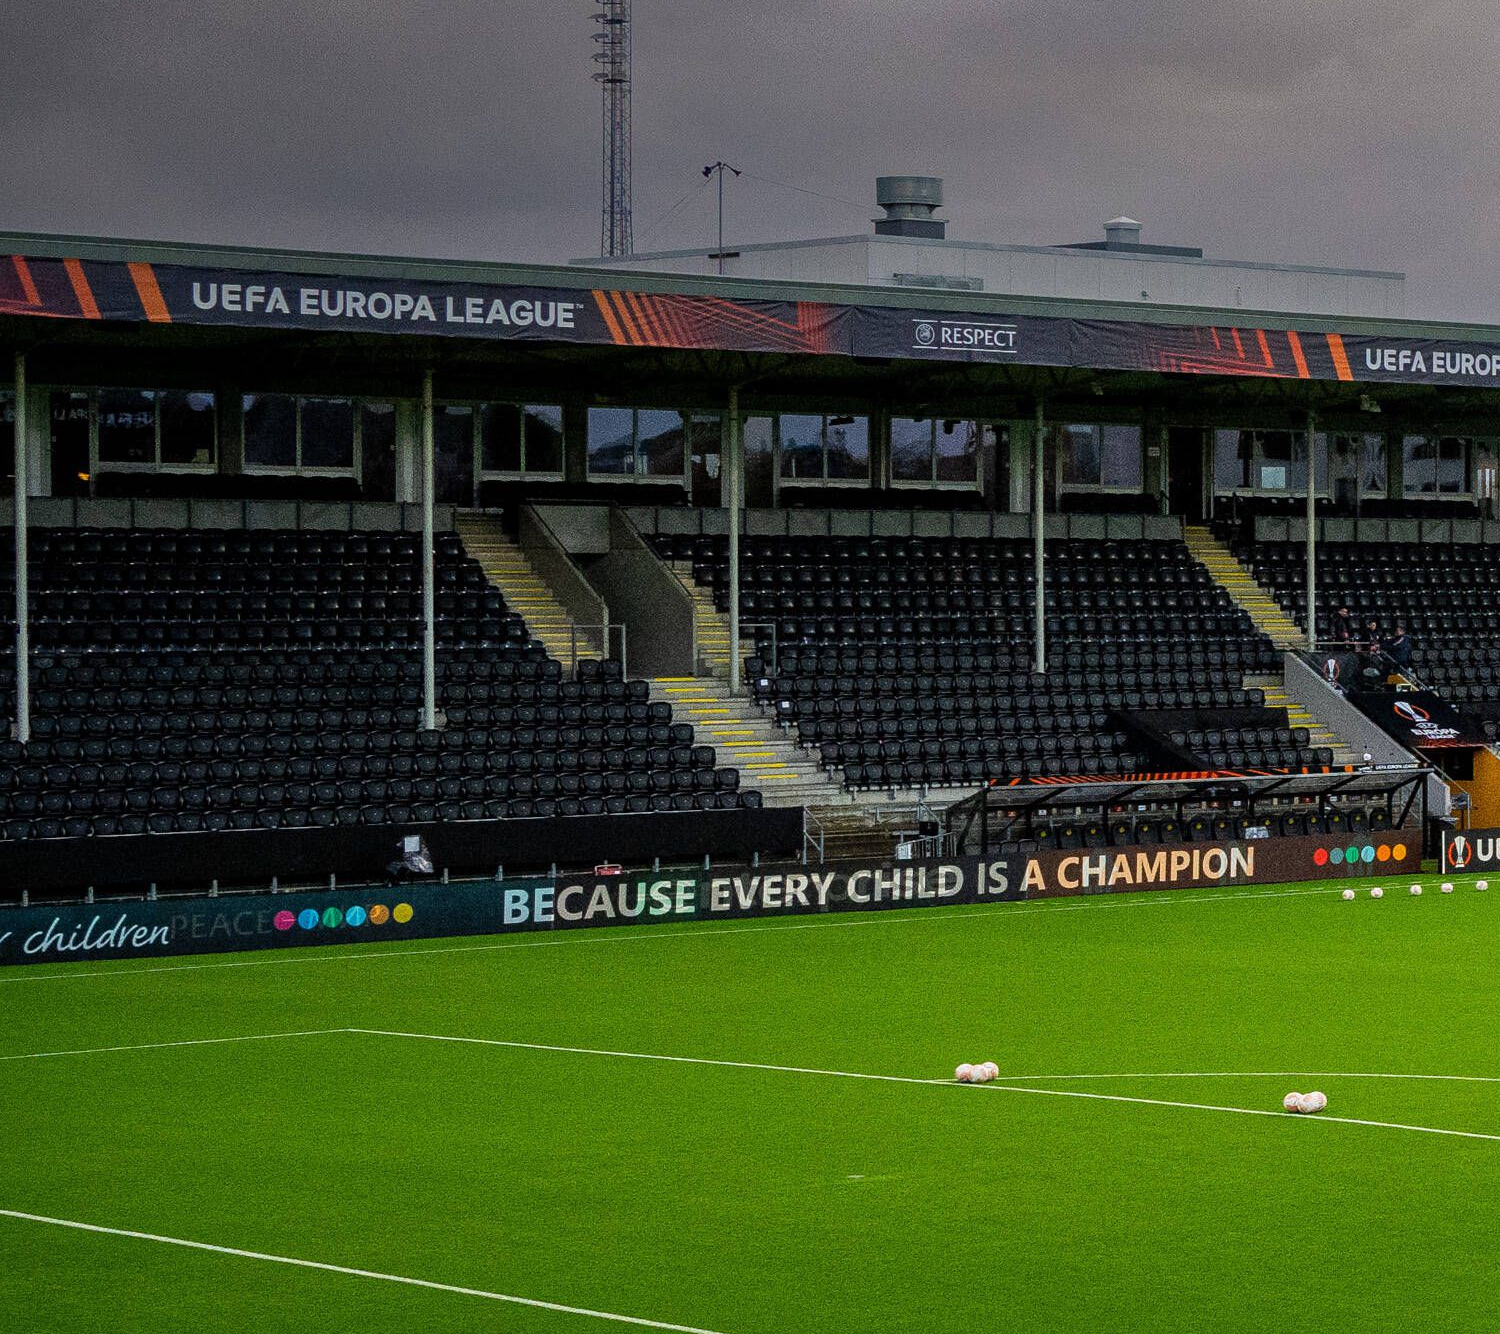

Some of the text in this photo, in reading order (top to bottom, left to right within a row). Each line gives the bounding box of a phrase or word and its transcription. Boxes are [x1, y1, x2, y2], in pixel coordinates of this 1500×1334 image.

[193, 282, 290, 314] UEFA
[300, 288, 437, 322] EUROPA
[941, 327, 1016, 347] RESPECT
[1365, 348, 1427, 373] UEFA
[503, 845, 1255, 925] BECAUSE EVERY CHILD IS A CHAMPION
[23, 914, 169, 954] children
